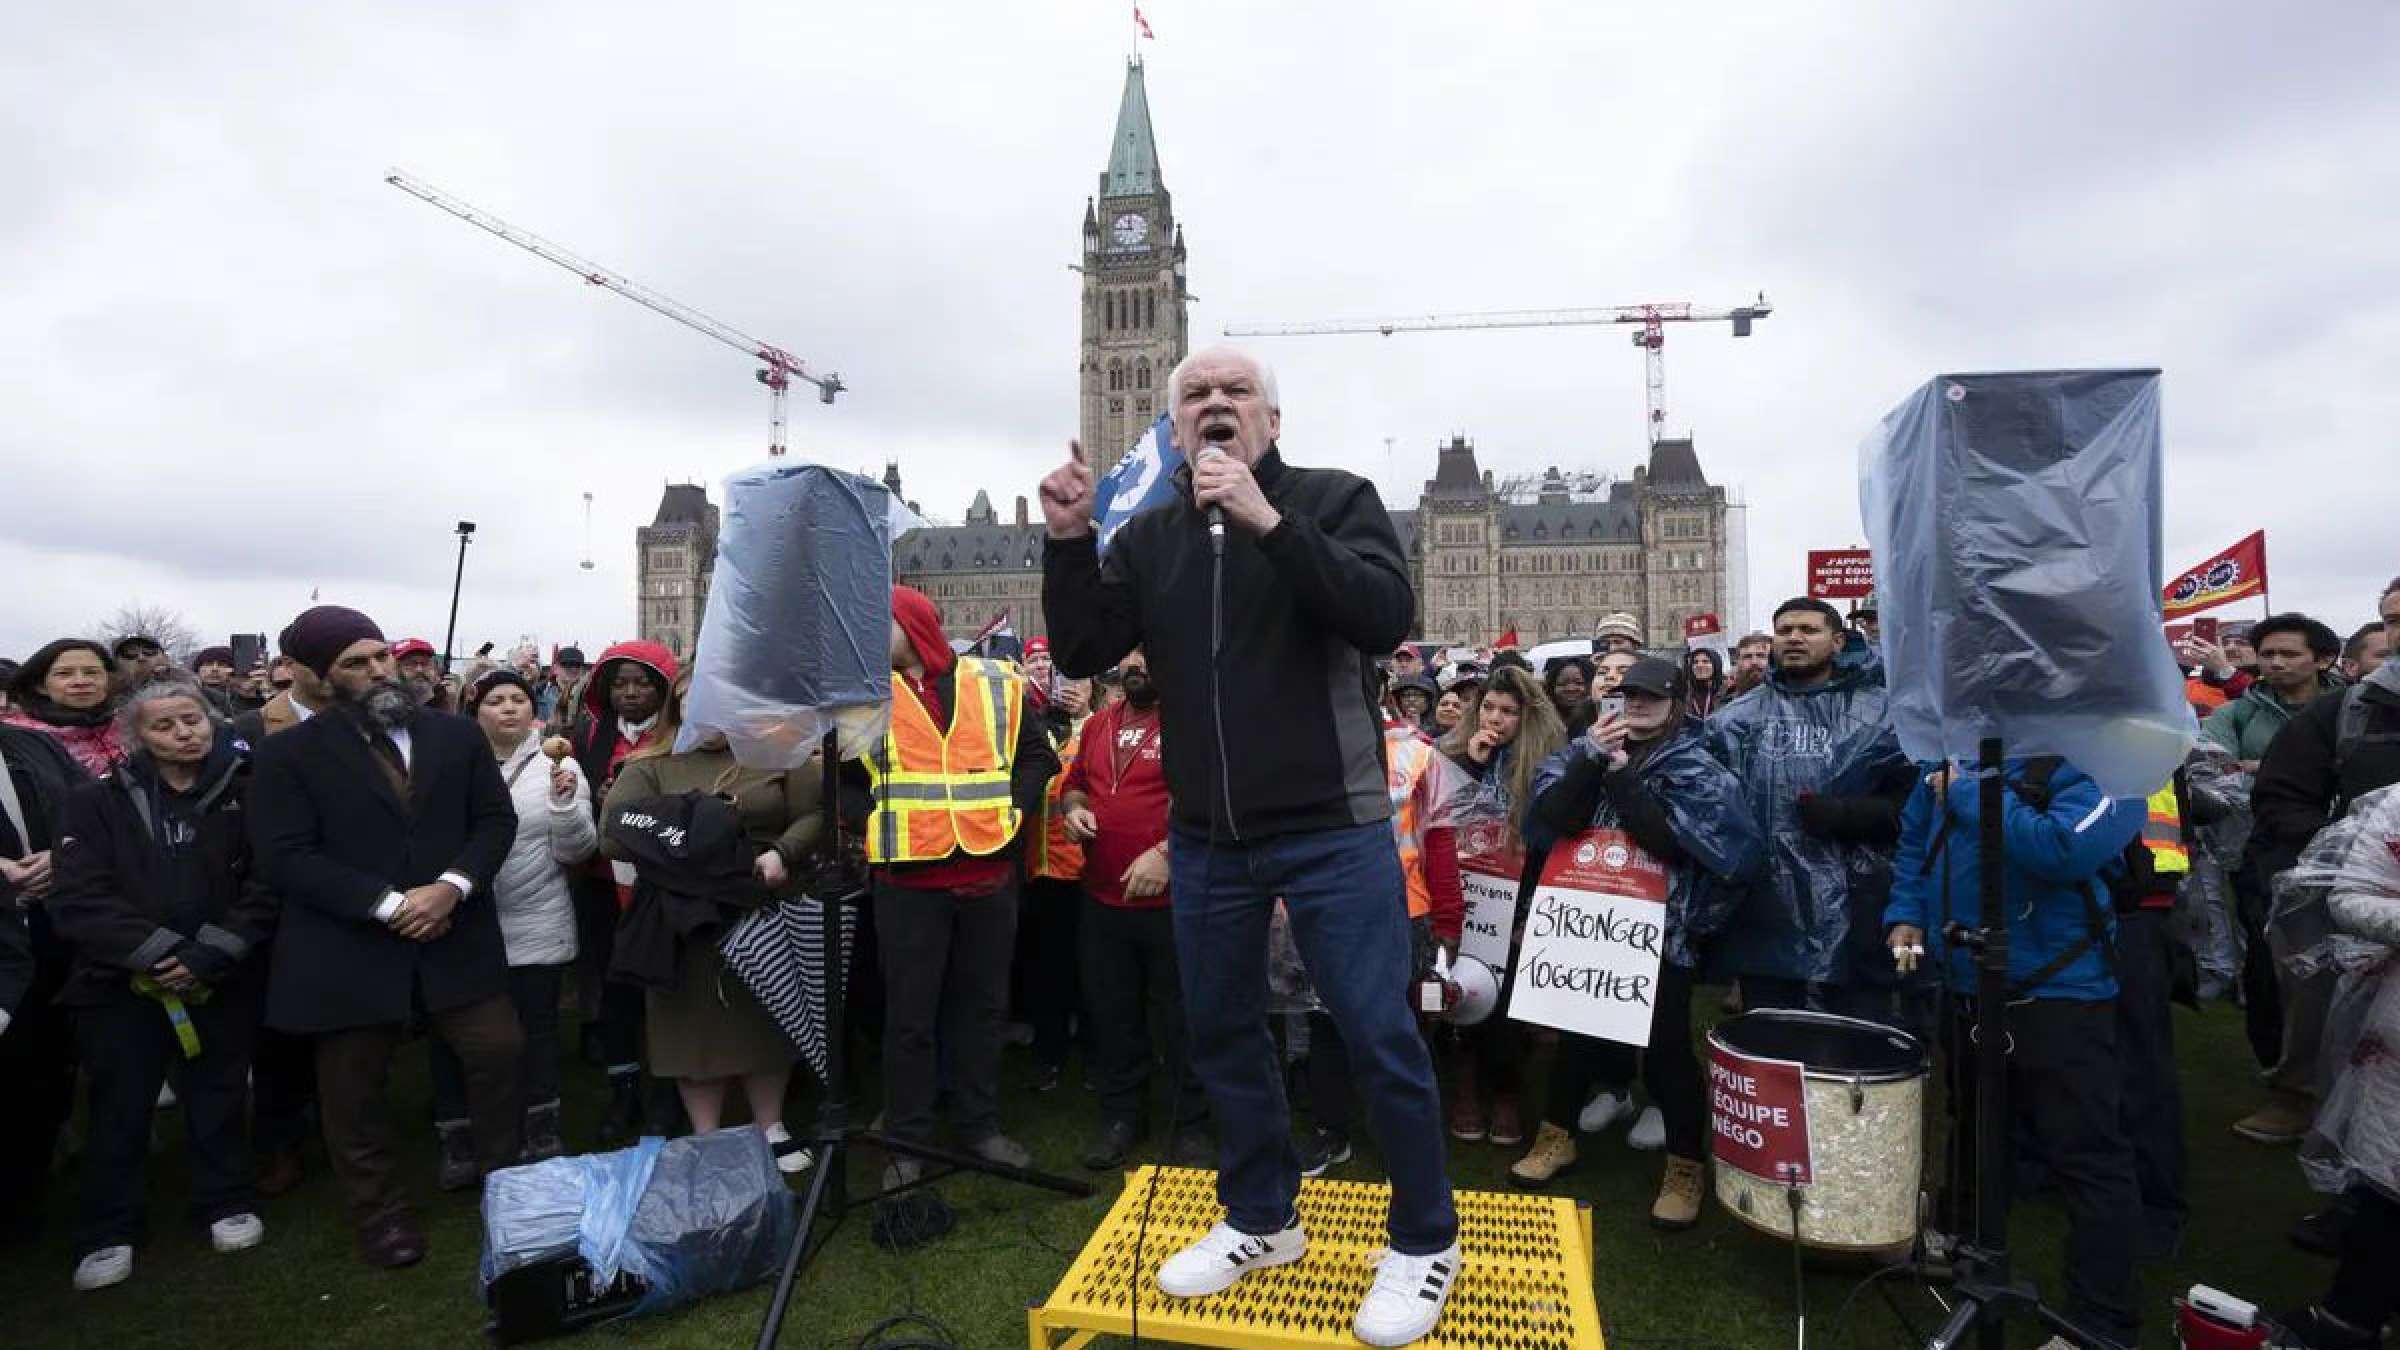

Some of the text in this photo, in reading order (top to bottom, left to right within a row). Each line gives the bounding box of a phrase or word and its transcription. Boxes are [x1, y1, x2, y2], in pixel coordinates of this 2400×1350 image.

[1815, 567, 1842, 576] MON
[1825, 577, 1841, 585] DE
[1533, 895, 1661, 958] STRONGER
[1519, 946, 1651, 1007] TOGETHER
